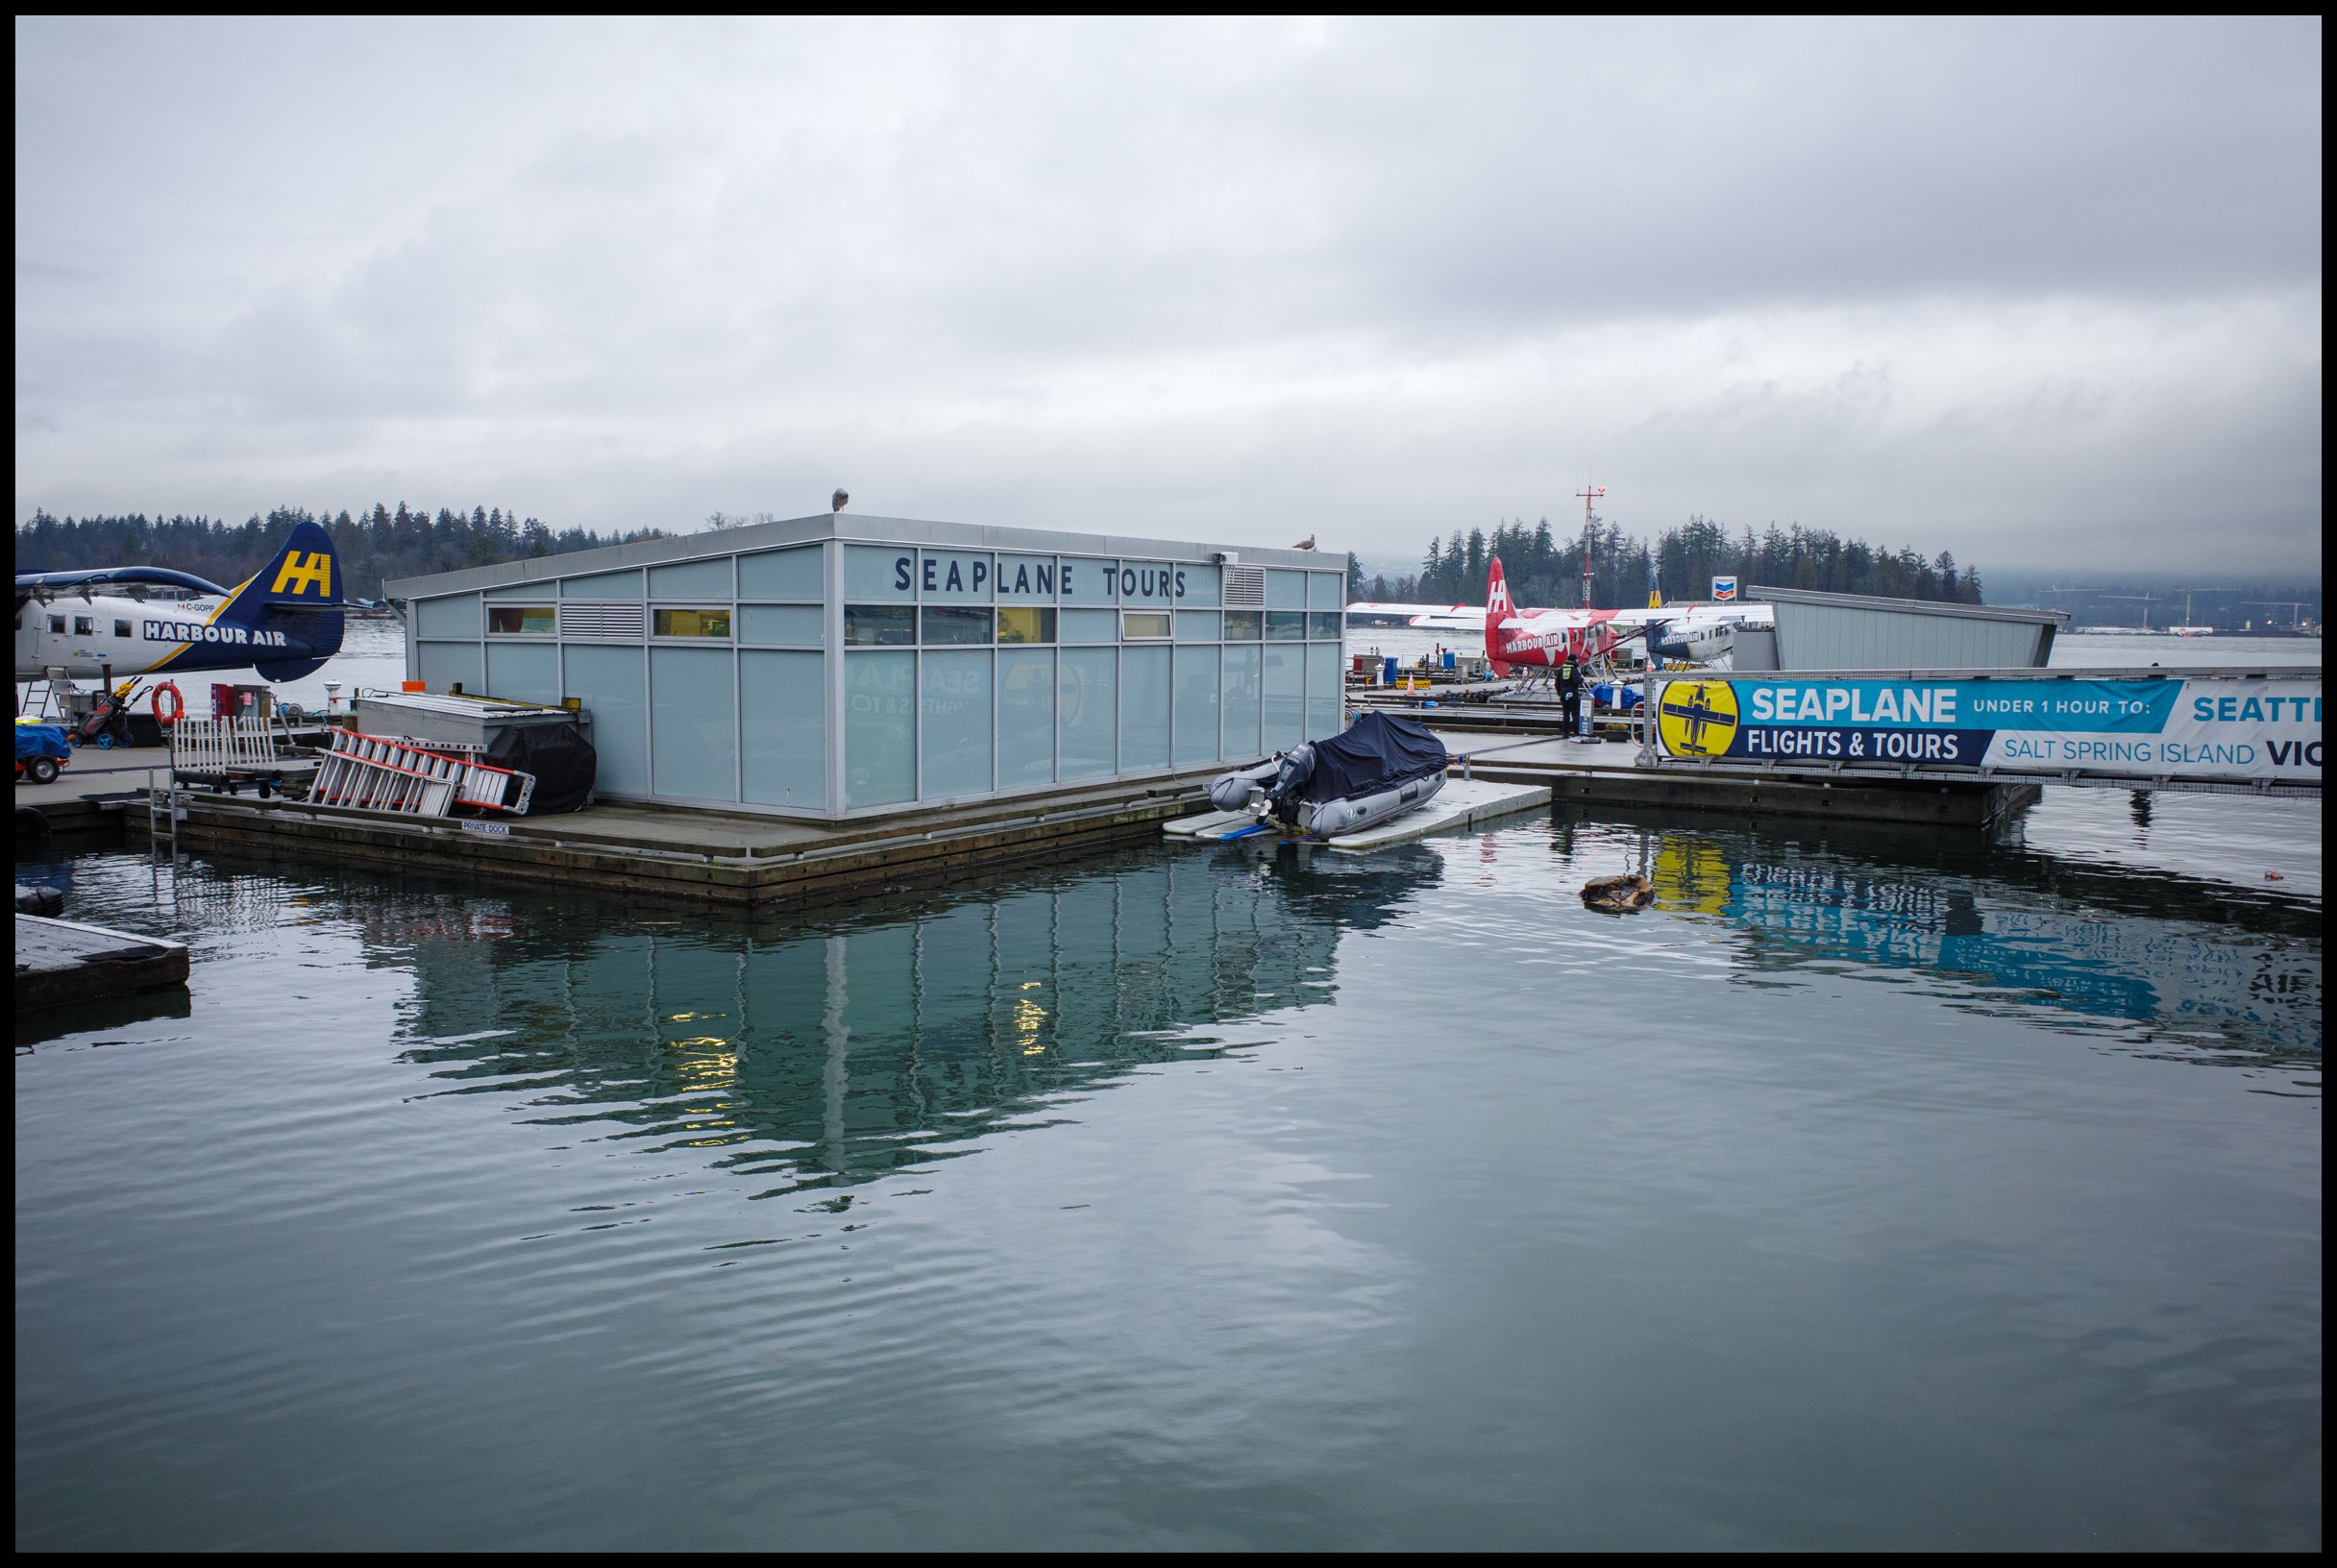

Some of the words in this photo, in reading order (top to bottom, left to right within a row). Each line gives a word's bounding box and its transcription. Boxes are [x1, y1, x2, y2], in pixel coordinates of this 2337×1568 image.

[895, 557, 1073, 595] SEAPLANE
[1102, 568, 1186, 598] TOURS
[186, 602, 215, 612] C-GOPP
[144, 621, 249, 645] HARBOUR
[252, 630, 287, 647] AIR
[1506, 636, 1543, 654] HARBOUR
[1545, 634, 1559, 648] AIR
[1660, 633, 1688, 647] HARBOUR
[1752, 688, 1957, 723] SEAPLANE
[1973, 699, 2034, 713] UNDER
[2041, 700, 2049, 713] 1
[2056, 700, 2109, 714] HOUR
[2118, 700, 2151, 715] TO:
[1748, 729, 1841, 755] FLIGHTS
[1849, 732, 1864, 756] &
[1873, 733, 1958, 760] TOURS
[2005, 739, 2056, 759] SALT
[2063, 741, 2152, 762] SPRING
[2160, 743, 2255, 765] ISLAND
[464, 822, 486, 832] PRIVATE
[489, 825, 506, 834] DOCK
